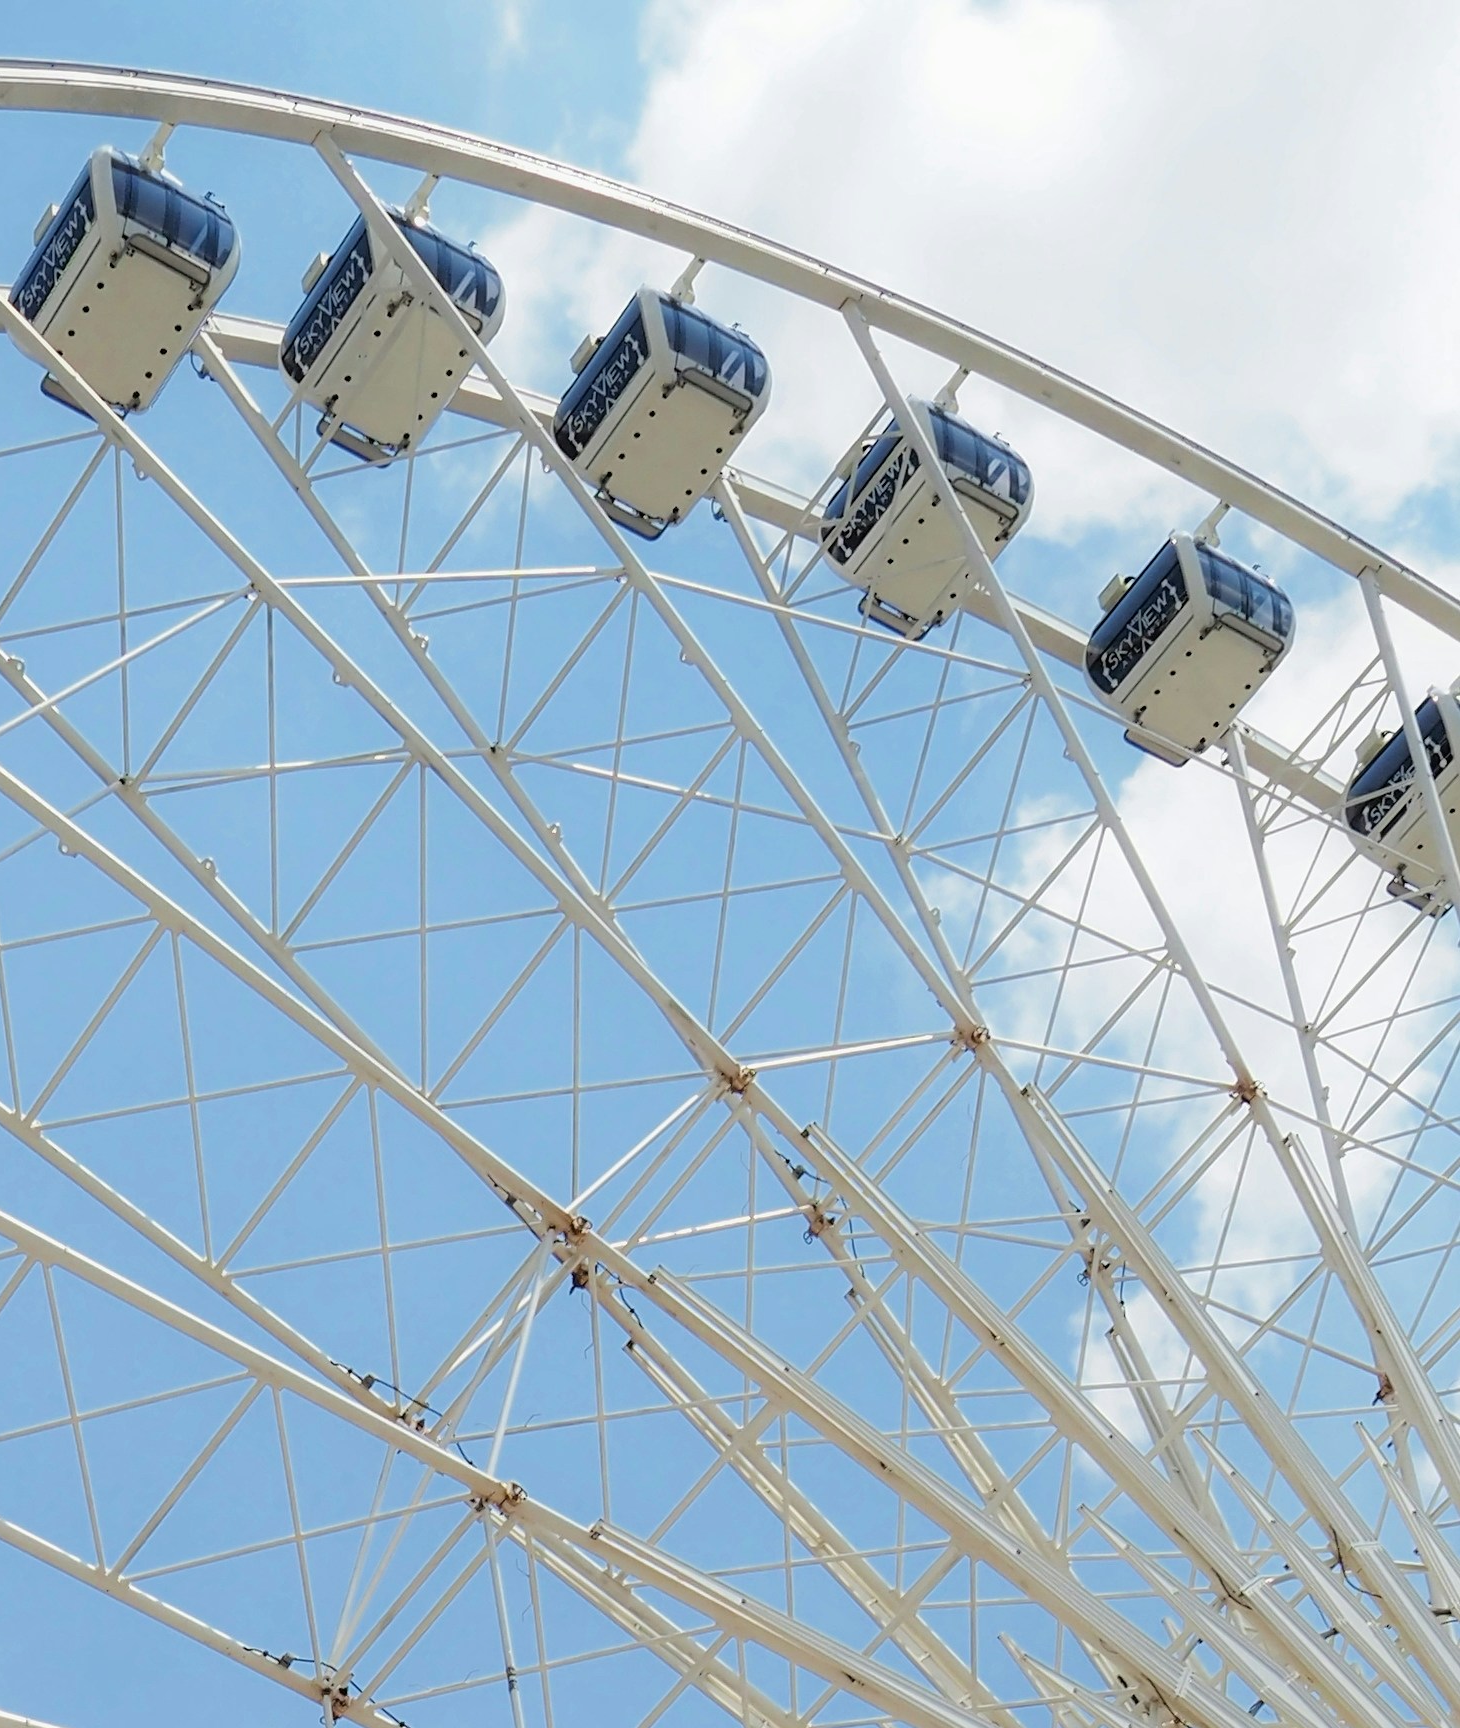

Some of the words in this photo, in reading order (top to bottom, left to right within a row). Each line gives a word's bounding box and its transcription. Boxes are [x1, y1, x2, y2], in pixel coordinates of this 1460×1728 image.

[24, 211, 78, 308] SKYVIEW
[300, 262, 356, 355] SKYVIEW
[574, 346, 630, 433] SKYVIEW
[1108, 590, 1167, 670] SKYVIEW
